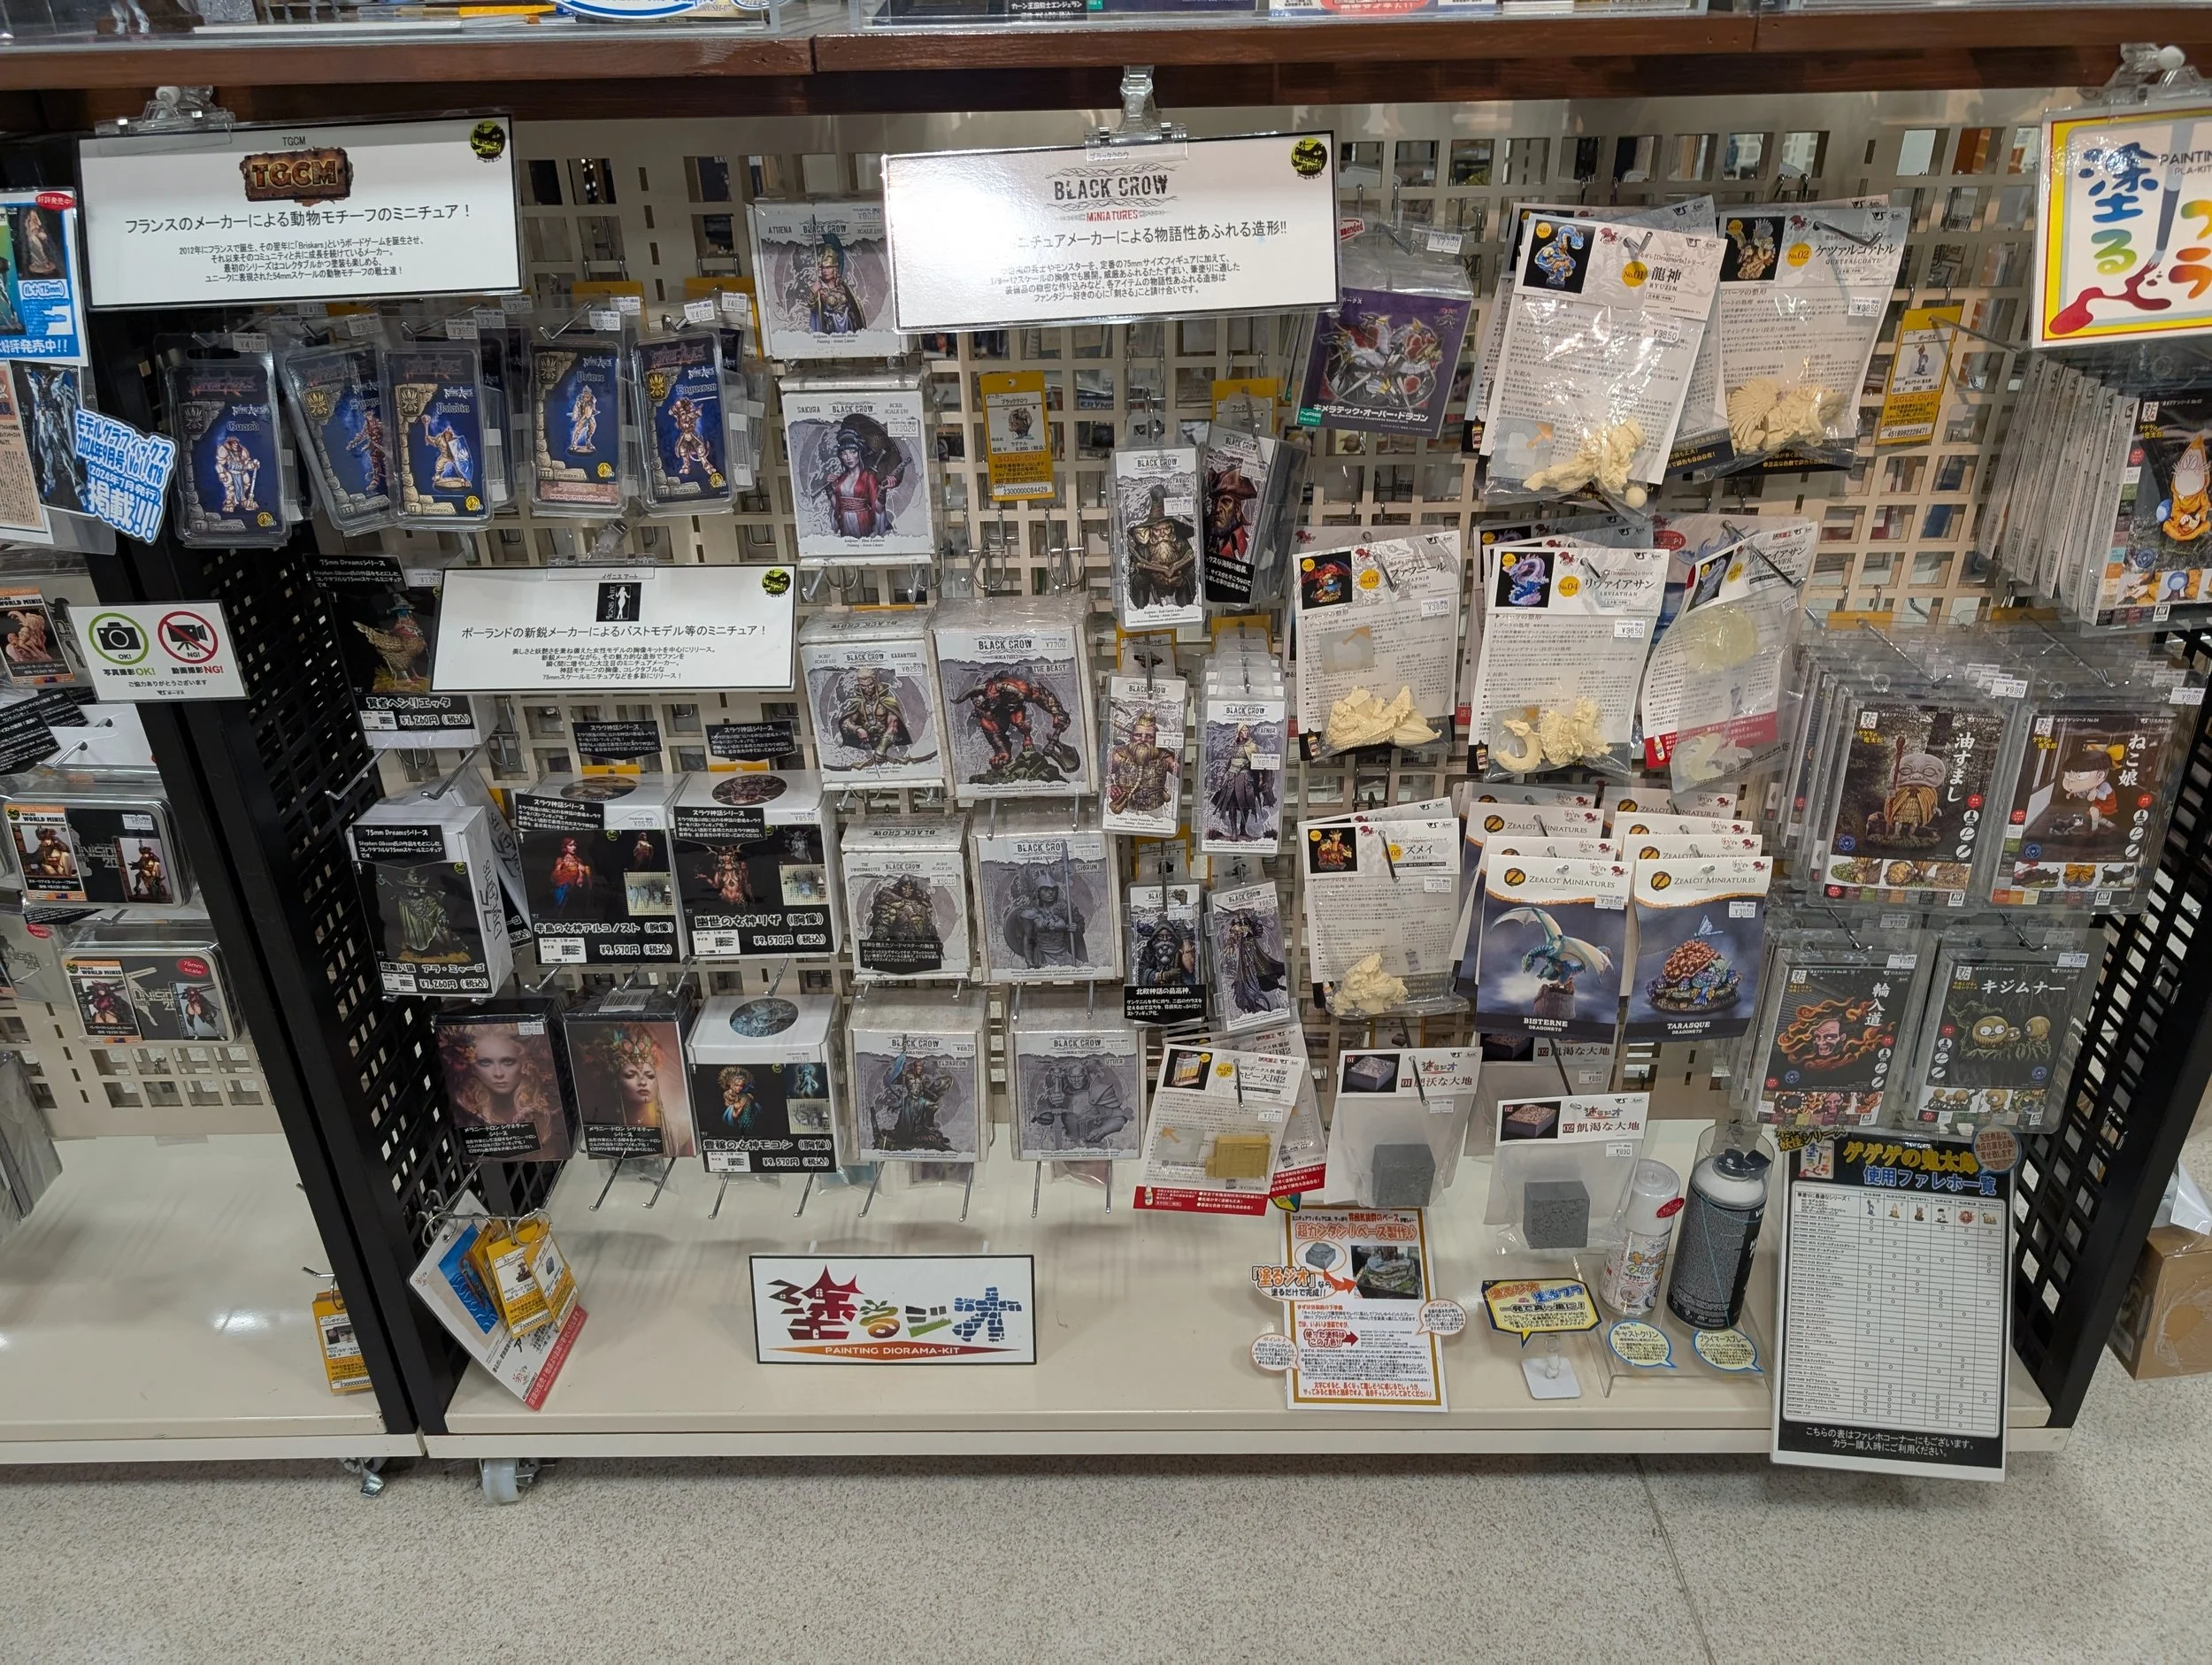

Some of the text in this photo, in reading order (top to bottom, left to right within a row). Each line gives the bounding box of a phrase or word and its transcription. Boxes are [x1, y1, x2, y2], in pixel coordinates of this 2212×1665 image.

[281, 135, 307, 147] TGCM
[251, 159, 338, 188] TGCM
[2174, 165, 2212, 175] PLA-KIT
[1054, 174, 1169, 201] BLACK CROW
[125, 204, 472, 234] フランスのメーカーによる動物モチーフのミニチュア！
[1086, 209, 1139, 222] MINIATURES
[768, 226, 793, 234] ATHENA
[803, 223, 847, 234] BLACK CROW
[211, 248, 395, 264] それ以来そのコミュニティと共に成長を続けているメーカー。
[1651, 265, 1682, 284] 龍神
[1856, 303, 1879, 313] ¥3850
[1653, 329, 1678, 341] ¥3850
[1893, 394, 1935, 403] SOLD OUT
[832, 403, 874, 414] BLACK CROW
[997, 454, 1021, 463] SOLD
[1137, 457, 1178, 468] BLACK CROW
[88, 479, 162, 541] 掲載!!
[1584, 578, 1655, 591] リヴァイアサン
[1427, 602, 1448, 611] ¥3850
[461, 625, 766, 640] ポーランドの新鋭メーカーによるバストモデル等のミニチュア！
[1621, 626, 1644, 635] ¥3850
[978, 639, 1033, 650] BLACK CROW
[846, 653, 885, 662] BLACK CROW
[103, 667, 157, 676] 写真撮影OK!
[172, 665, 224, 675] 動画撮影NG!
[1046, 664, 1069, 672] BEAST
[2005, 686, 2025, 695] ¥990
[2181, 693, 2201, 702] ¥990
[1225, 706, 1266, 715] BLACK CROW
[2117, 733, 2147, 787] ねこ娘
[1947, 731, 1976, 803] 油すまし
[1017, 842, 1043, 853] BLACK
[1406, 844, 1433, 856] ズメイ
[885, 863, 905, 871] BLACK
[1076, 863, 1099, 871] SIGRUN
[1529, 874, 1616, 889] ZEALOT MINIATURES
[1674, 874, 1756, 886] ZEALOT MINIATURES
[1600, 898, 1623, 907] ¥3850
[1980, 978, 2067, 995] キジムナー
[1864, 982, 1892, 1027] 輪入道
[1523, 1017, 1569, 1028] BISTERNE
[1667, 1021, 1711, 1031] TARASQUE
[918, 1038, 940, 1048] CROW
[1053, 1038, 1102, 1048] BLACK CROW
[1402, 1078, 1412, 1087] 01
[1563, 1124, 1575, 1133] 02
[1843, 1139, 1980, 1175] ゲゲゲの鬼太郎
[1863, 1165, 1997, 1196] 使用ファレホ一覧
[1271, 1287, 1326, 1298] 塗るだけで完成!!
[1613, 1330, 1660, 1339] キャストクリン
[825, 1346, 961, 1355] PAINTING DIORAMA-KIT
[1805, 1426, 1974, 1450] こちらの表はファレホコーナーにもございます。
[1832, 1438, 1947, 1458] カラー購入時にご利用ください。
